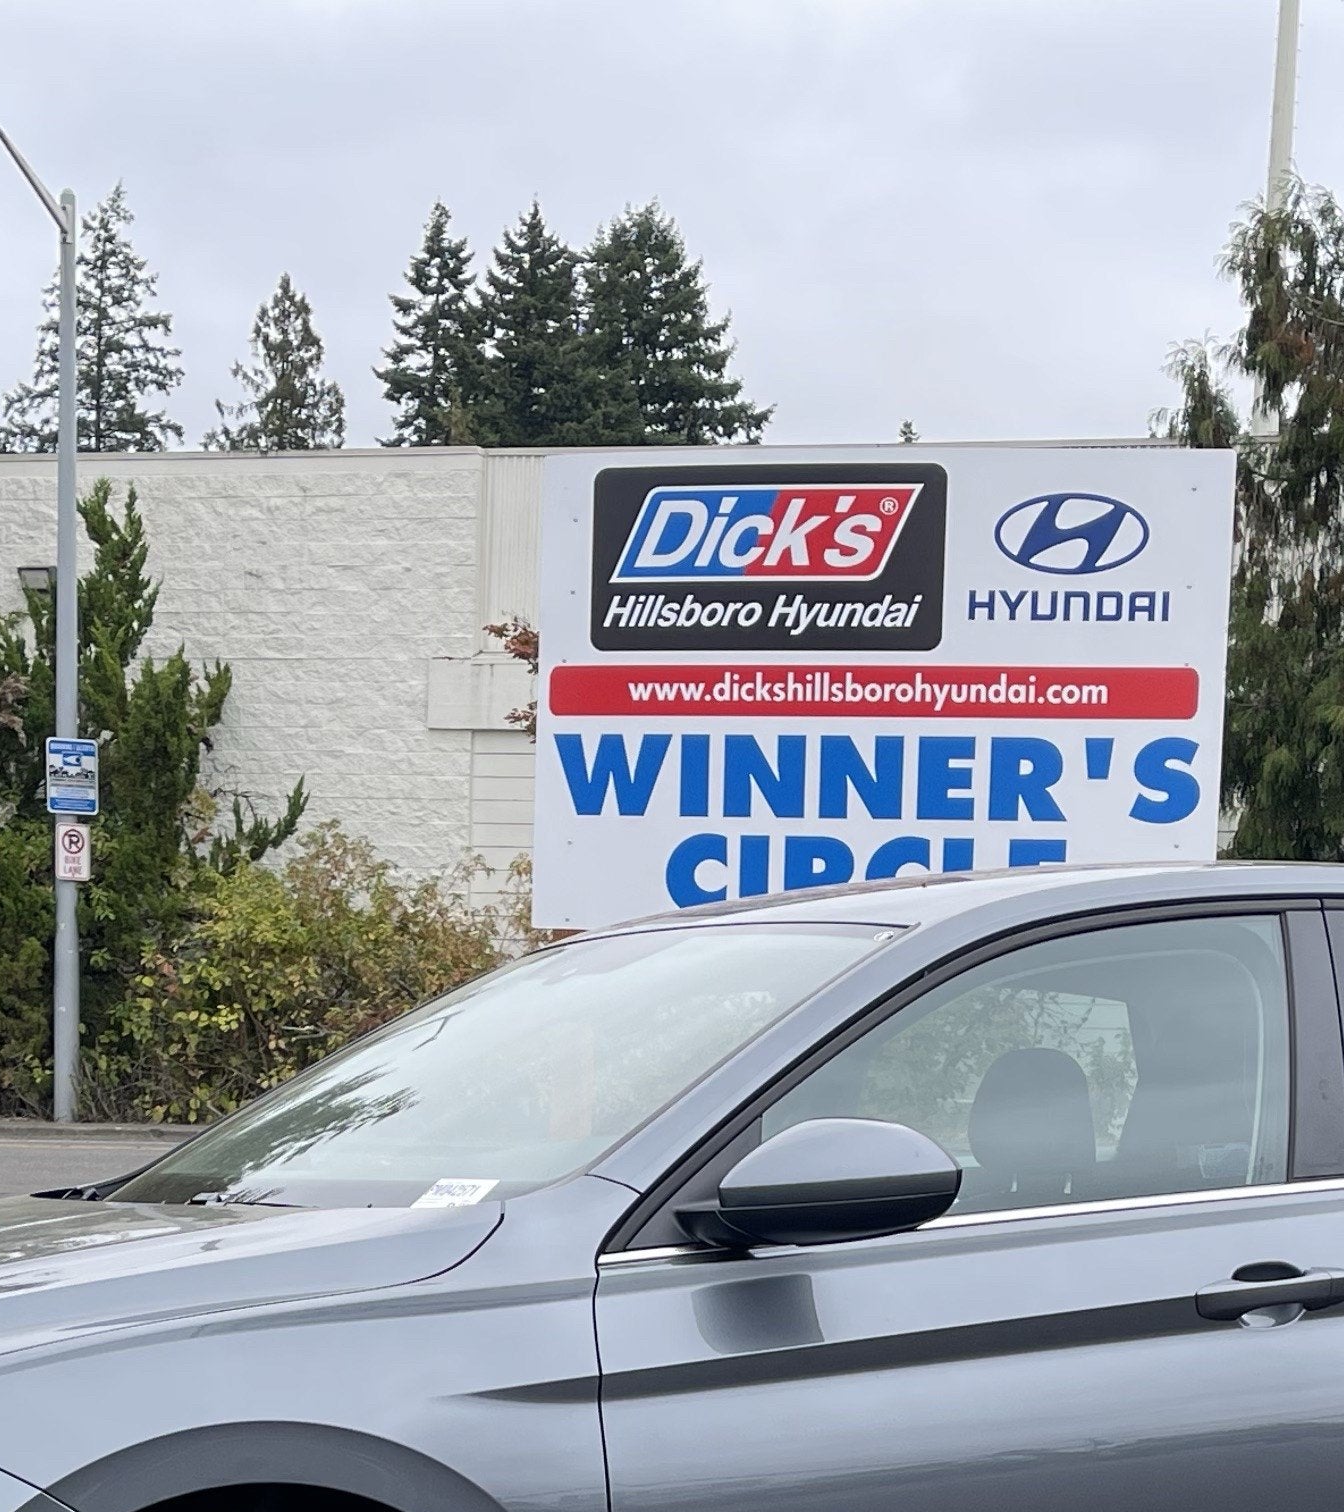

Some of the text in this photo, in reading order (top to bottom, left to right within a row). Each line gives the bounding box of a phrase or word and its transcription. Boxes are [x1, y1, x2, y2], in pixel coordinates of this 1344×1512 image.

[634, 492, 885, 569] Dick's
[602, 593, 924, 636] Hillsboro Hyundai
[967, 589, 1171, 623] HYUNDAI
[627, 670, 1109, 712] www.dickshillsborohyundai.com
[554, 733, 1201, 824] WINNER'S
